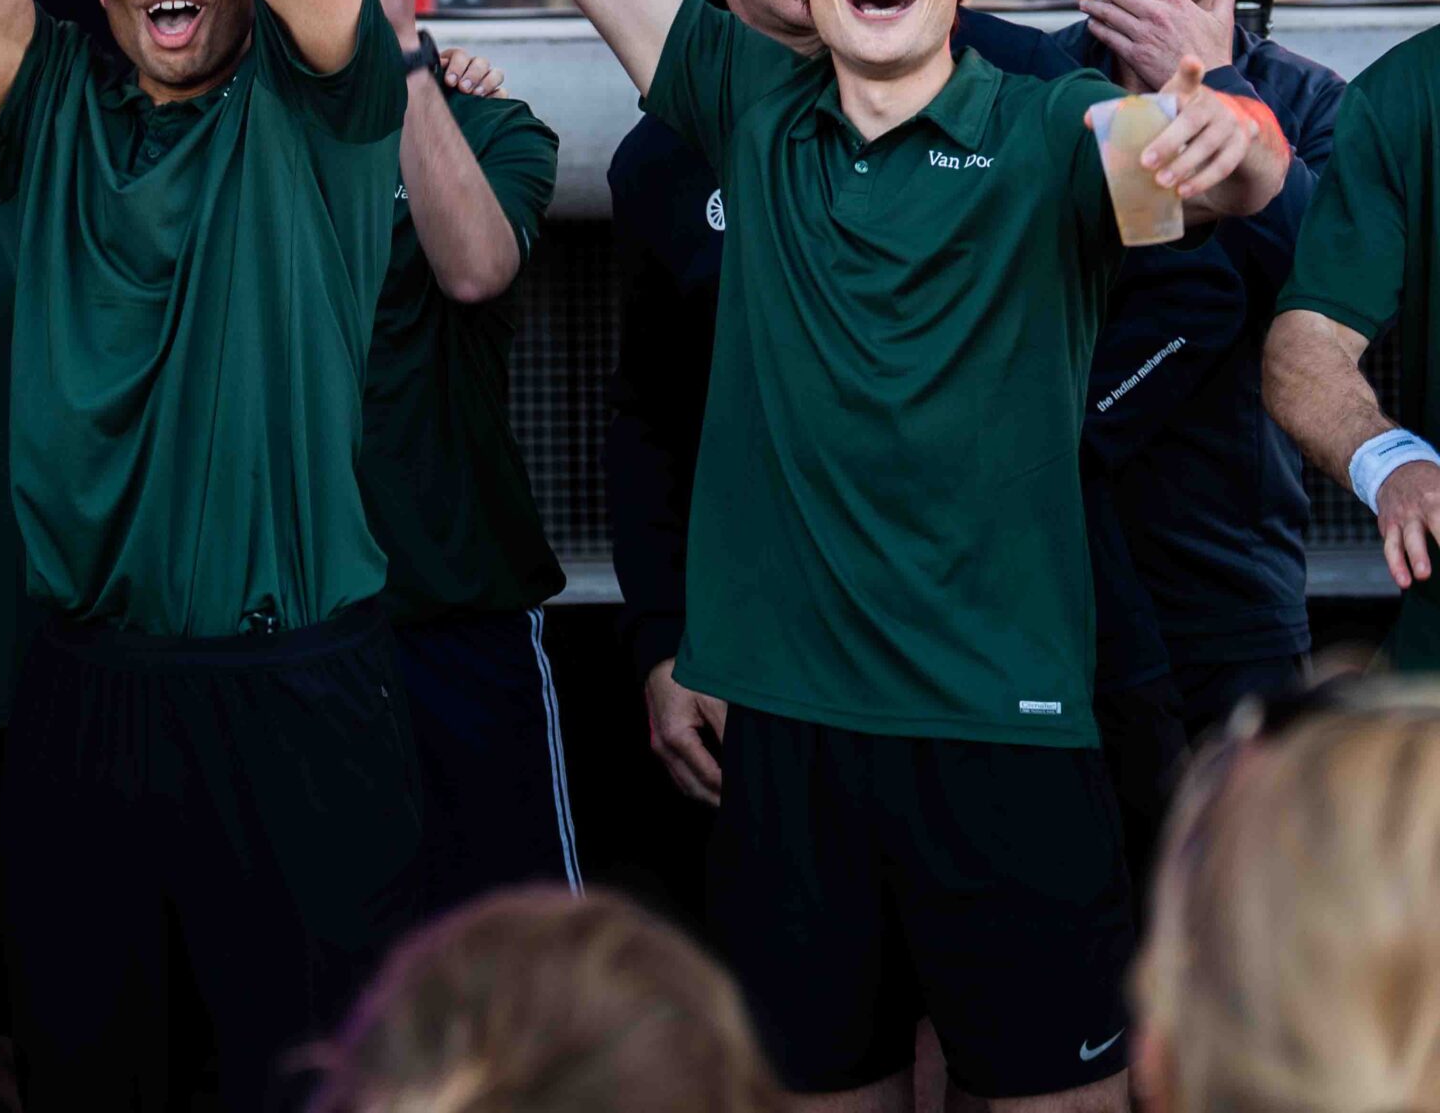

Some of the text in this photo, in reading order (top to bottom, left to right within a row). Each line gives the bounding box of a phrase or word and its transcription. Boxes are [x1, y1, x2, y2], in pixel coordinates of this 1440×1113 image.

[928, 150, 960, 169] Van
[394, 184, 409, 199] Va
[1096, 396, 1113, 412] the
[1111, 374, 1140, 400] indian
